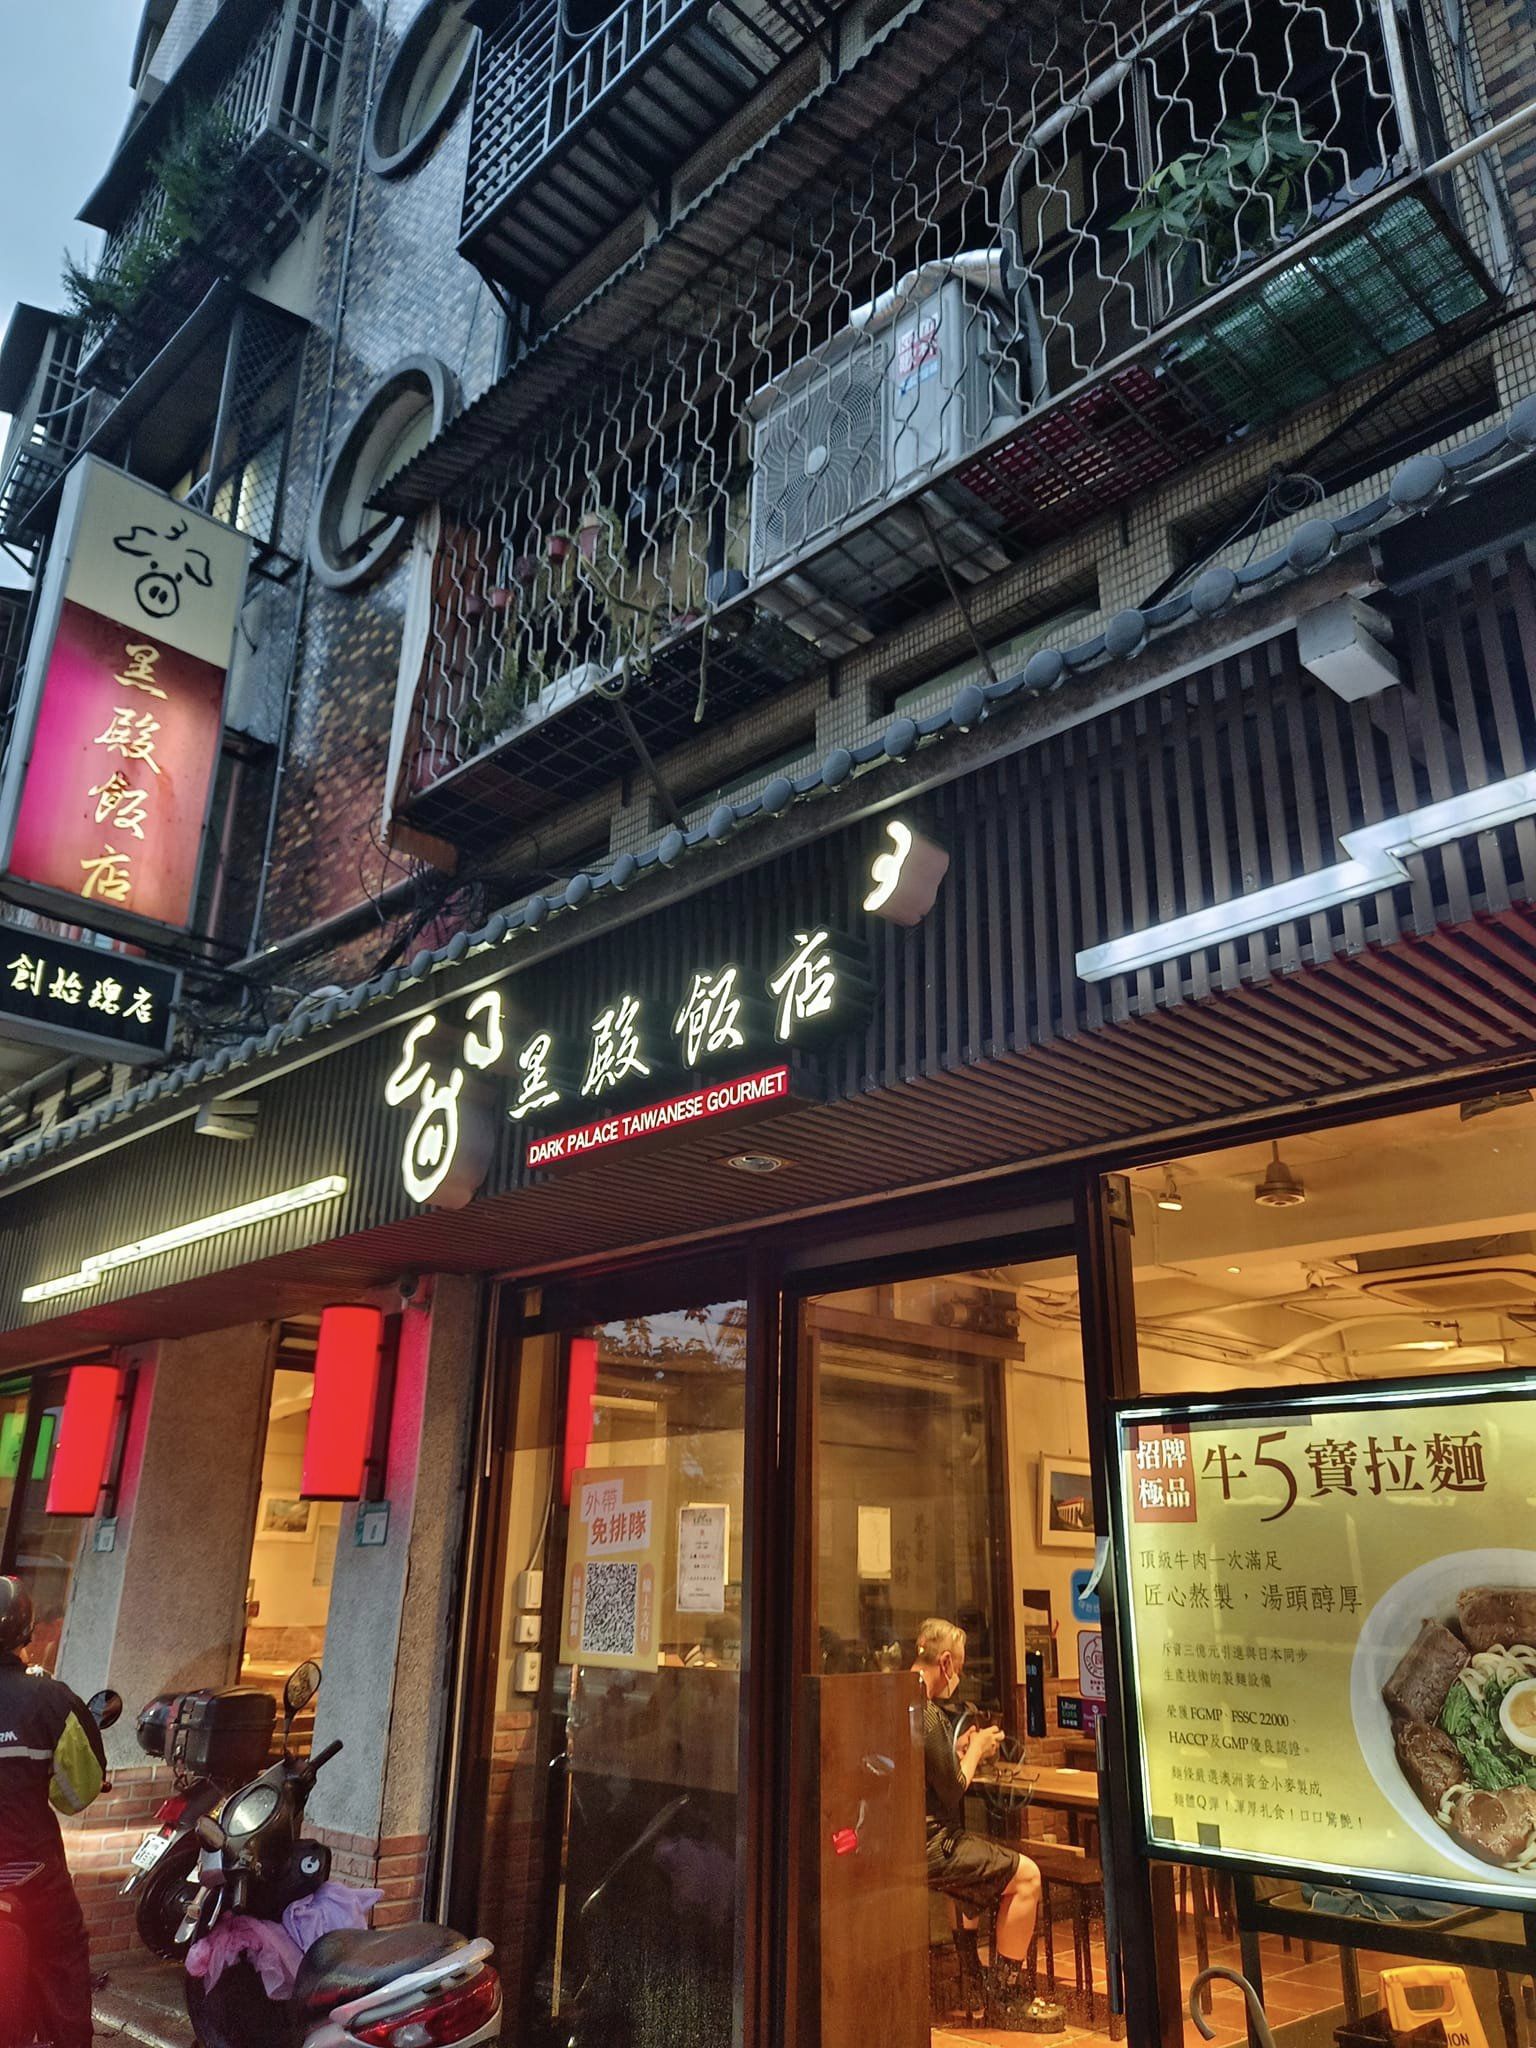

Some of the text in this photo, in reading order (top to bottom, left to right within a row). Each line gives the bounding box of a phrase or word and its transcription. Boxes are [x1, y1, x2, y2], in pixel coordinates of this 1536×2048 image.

[80, 643, 169, 901] 黑殿飯店
[508, 931, 836, 1119] 黑殿飯店
[529, 1070, 787, 1164] DARK PALACE TAIWANESE GOURMET
[1136, 1437, 1187, 1470] 招牌
[1138, 1477, 1191, 1510] 極品
[1201, 1430, 1489, 1523] 牛5寶拉麵
[585, 1489, 619, 1517] 外帶
[590, 1510, 648, 1546] 免排隊
[1140, 1549, 1283, 1572] 頂級牛肉一次滿足
